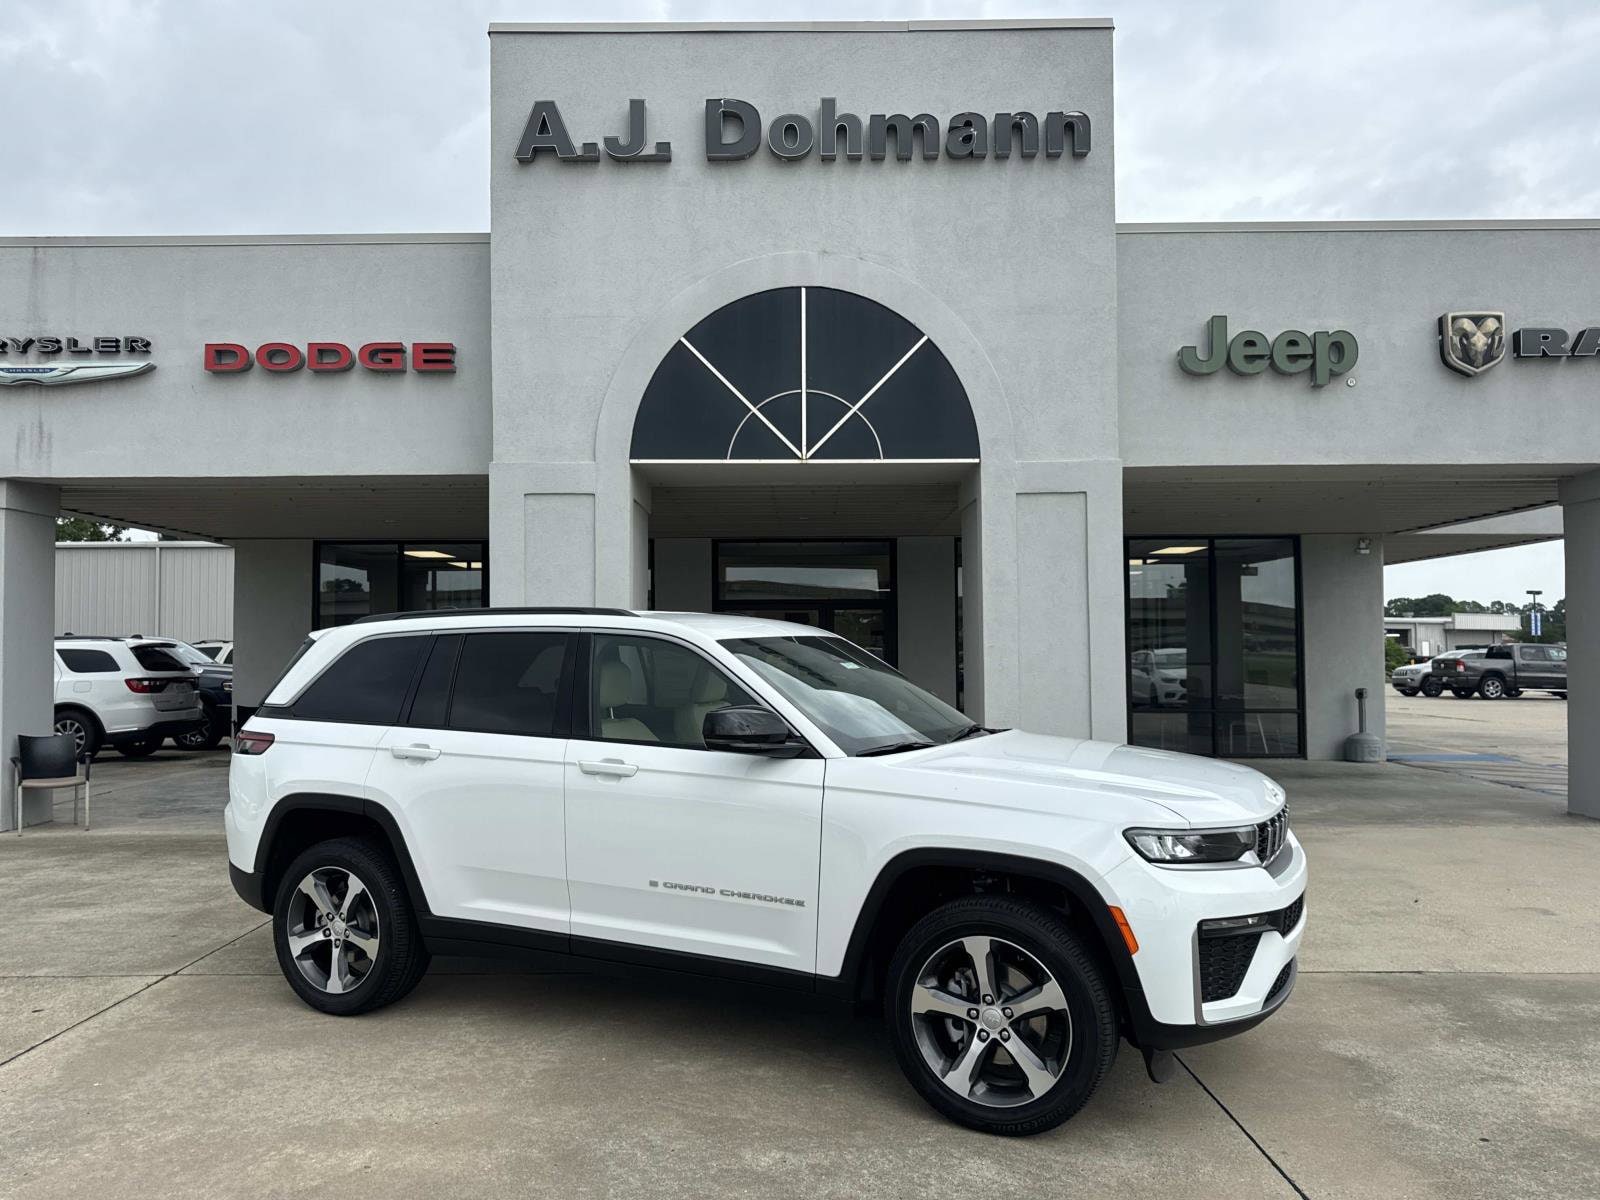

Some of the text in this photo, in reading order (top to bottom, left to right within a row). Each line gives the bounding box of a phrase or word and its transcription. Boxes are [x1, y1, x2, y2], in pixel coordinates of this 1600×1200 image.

[514, 97, 1092, 163] A.J. Dohmann
[0, 335, 152, 354] YSLER
[204, 342, 456, 374] DODGE
[1177, 315, 1359, 387] Jeep
[662, 880, 806, 907] GRAND CHEROKEE
